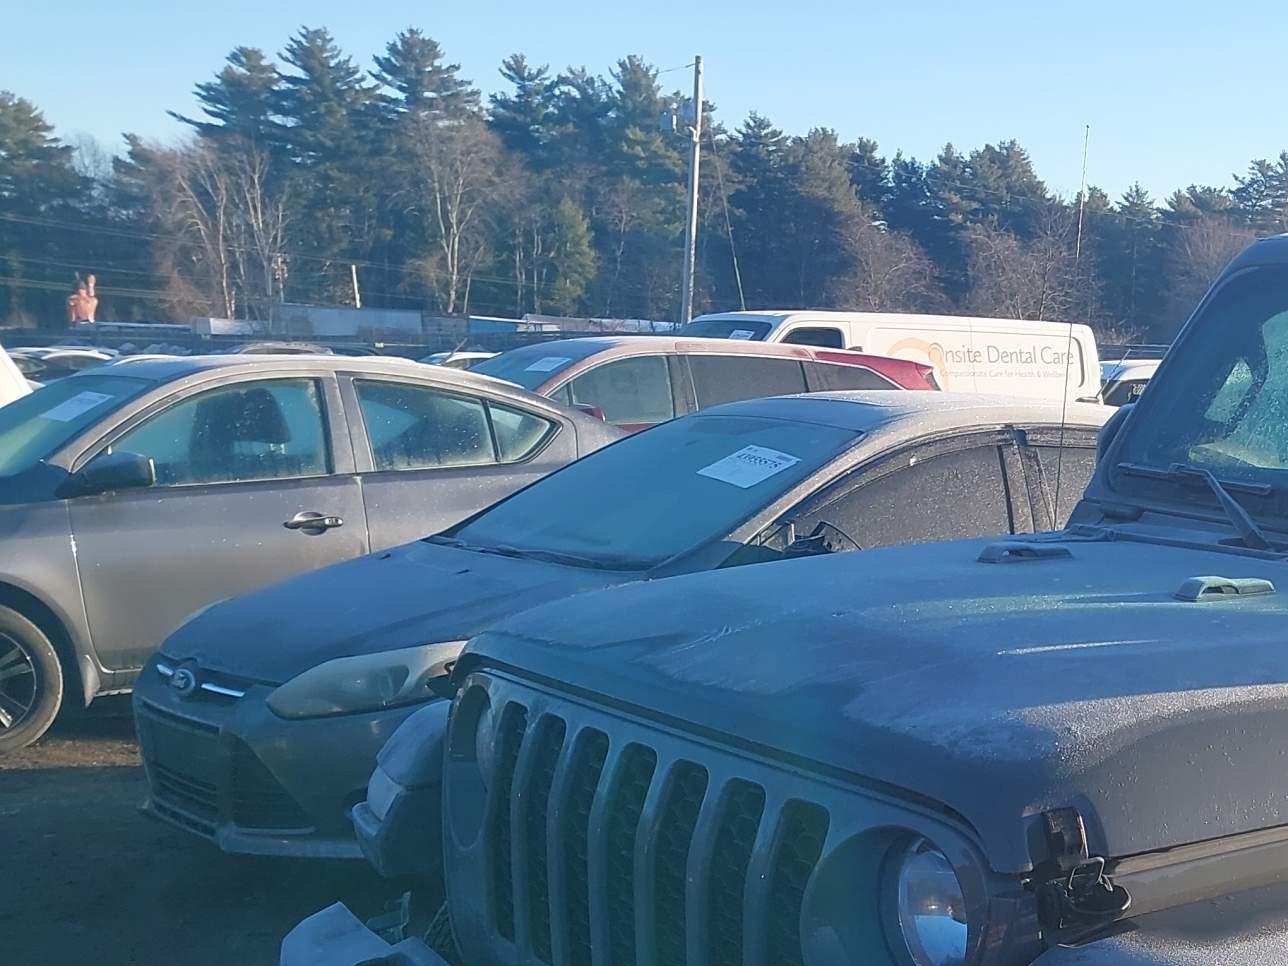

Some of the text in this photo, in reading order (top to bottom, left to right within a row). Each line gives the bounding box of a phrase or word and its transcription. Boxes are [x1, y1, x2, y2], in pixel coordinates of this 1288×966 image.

[928, 342, 1074, 365] Onsite Dental Care
